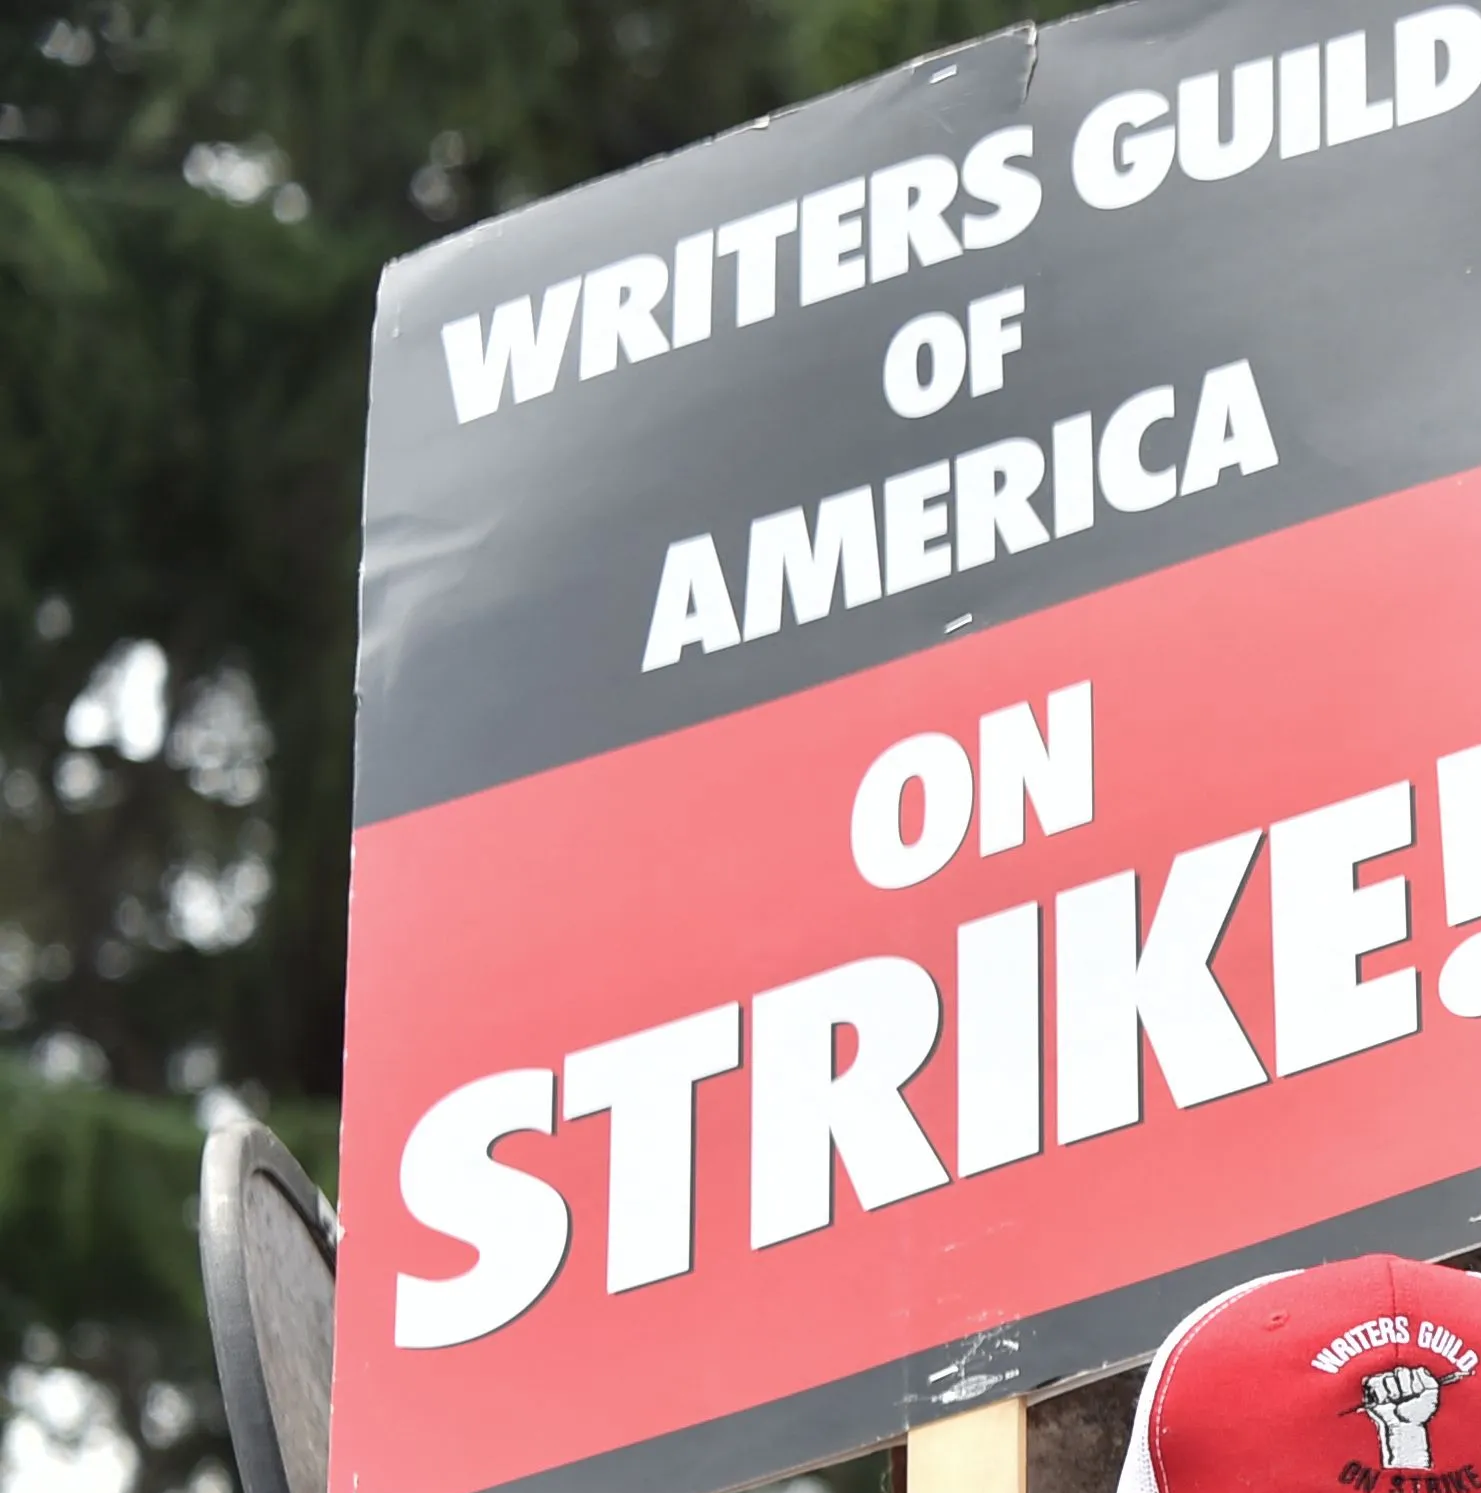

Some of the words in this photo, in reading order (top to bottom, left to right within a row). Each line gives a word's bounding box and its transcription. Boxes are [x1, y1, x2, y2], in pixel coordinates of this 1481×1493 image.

[441, 124, 1043, 425] WRITERS
[883, 285, 1027, 419] OF
[641, 358, 1281, 673] AMERICA
[850, 680, 1094, 891] ON
[1310, 1315, 1411, 1375] WRITERS
[1417, 1320, 1479, 1373] GUILD
